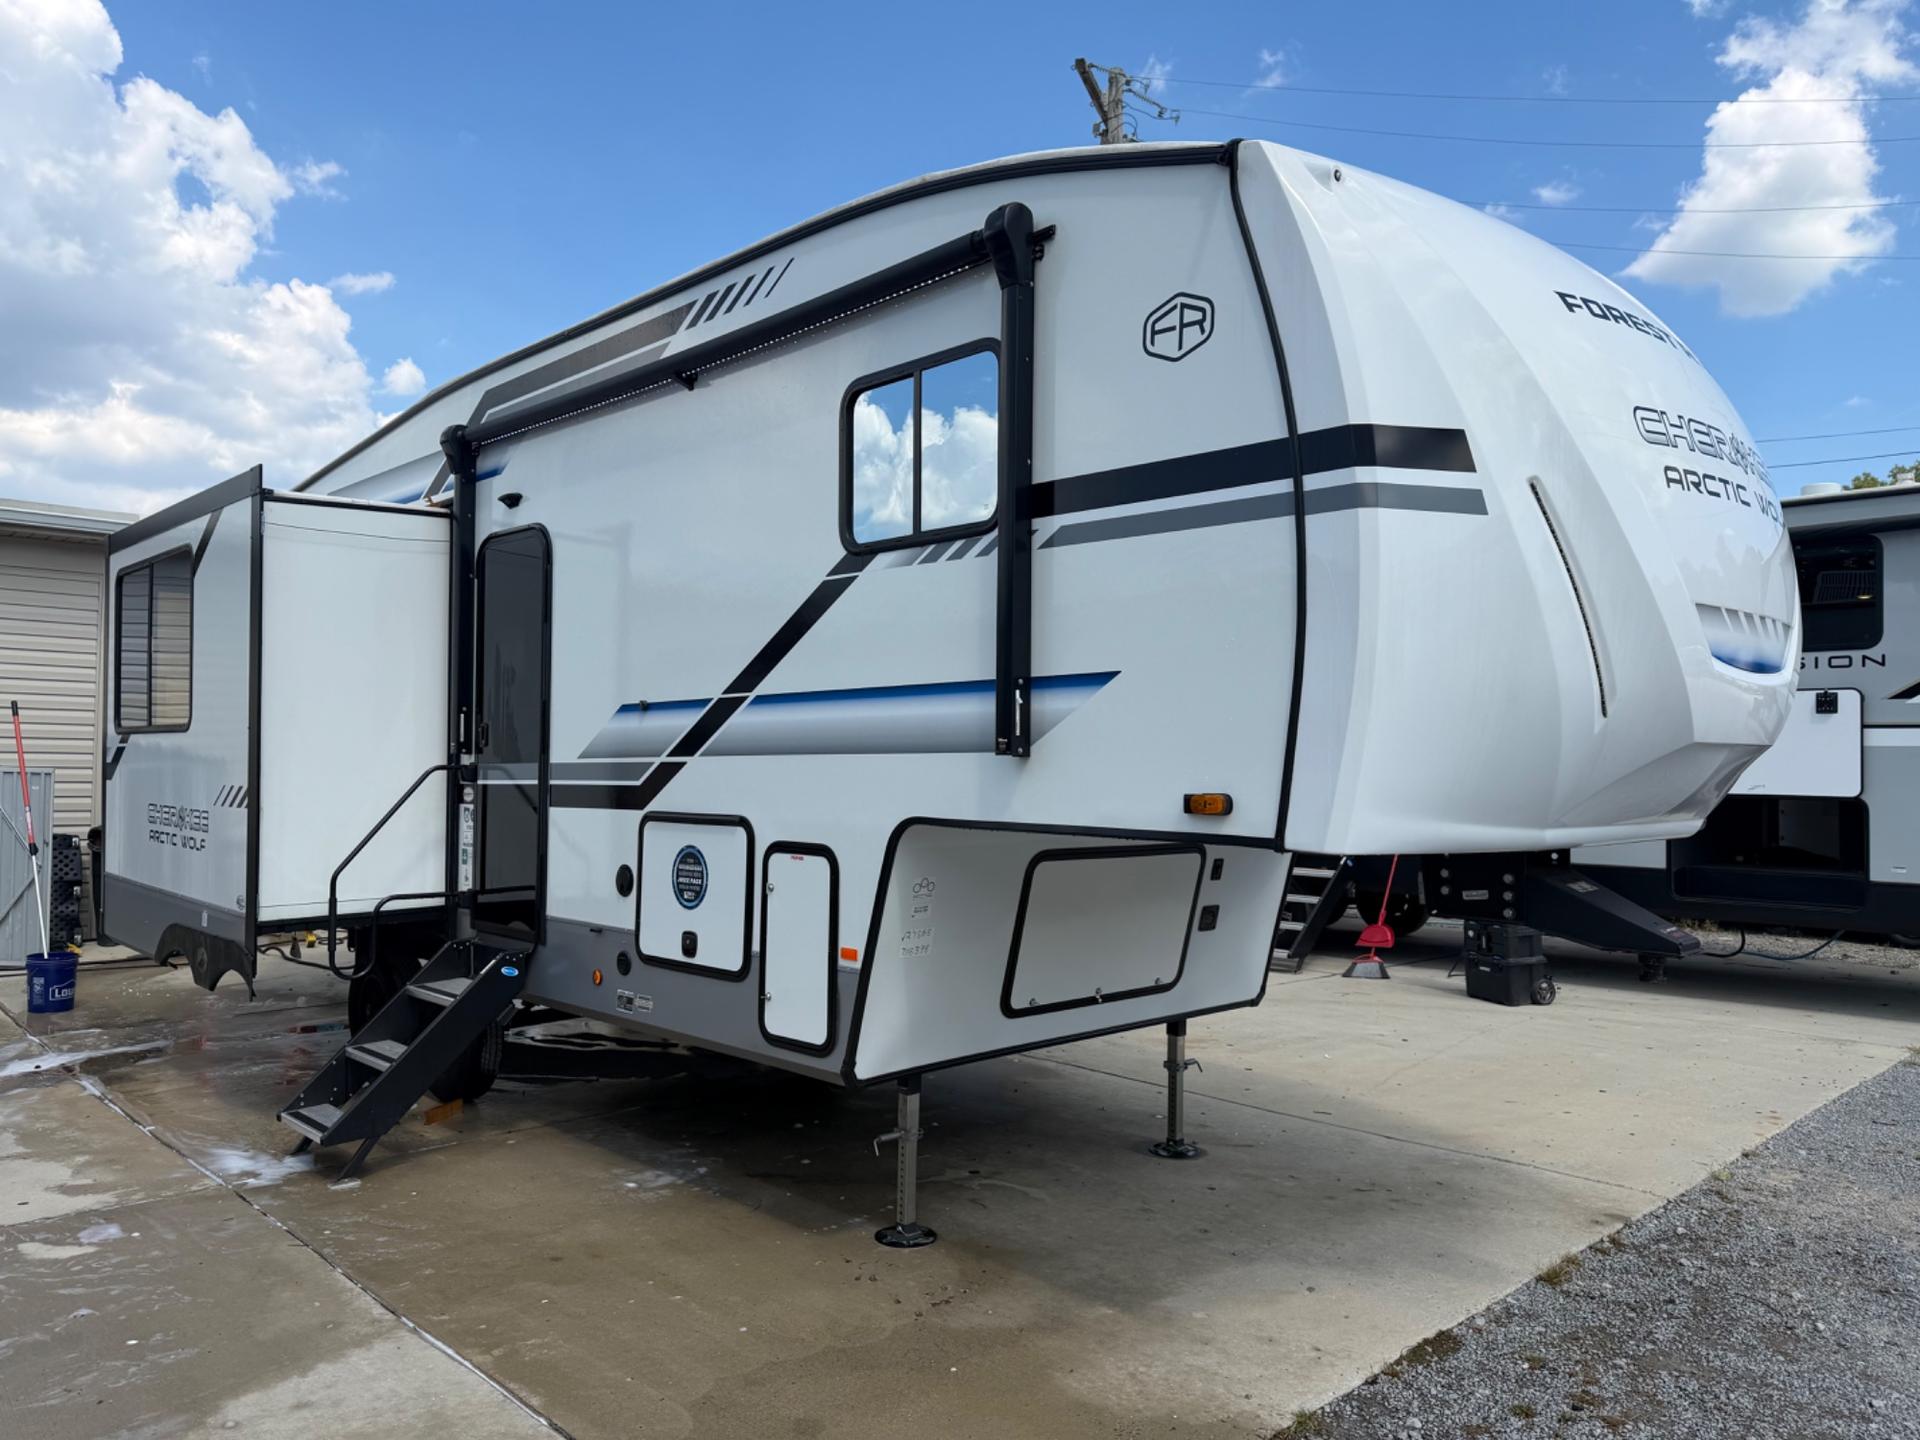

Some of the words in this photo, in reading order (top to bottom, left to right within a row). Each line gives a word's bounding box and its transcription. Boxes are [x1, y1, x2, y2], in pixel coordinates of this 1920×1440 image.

[1552, 289, 1678, 349] FOREST
[1633, 405, 1776, 490] CHEROKE
[1664, 465, 1752, 508] ARCTIC
[149, 829, 177, 847] ARCTIC
[180, 834, 207, 852] WOLF
